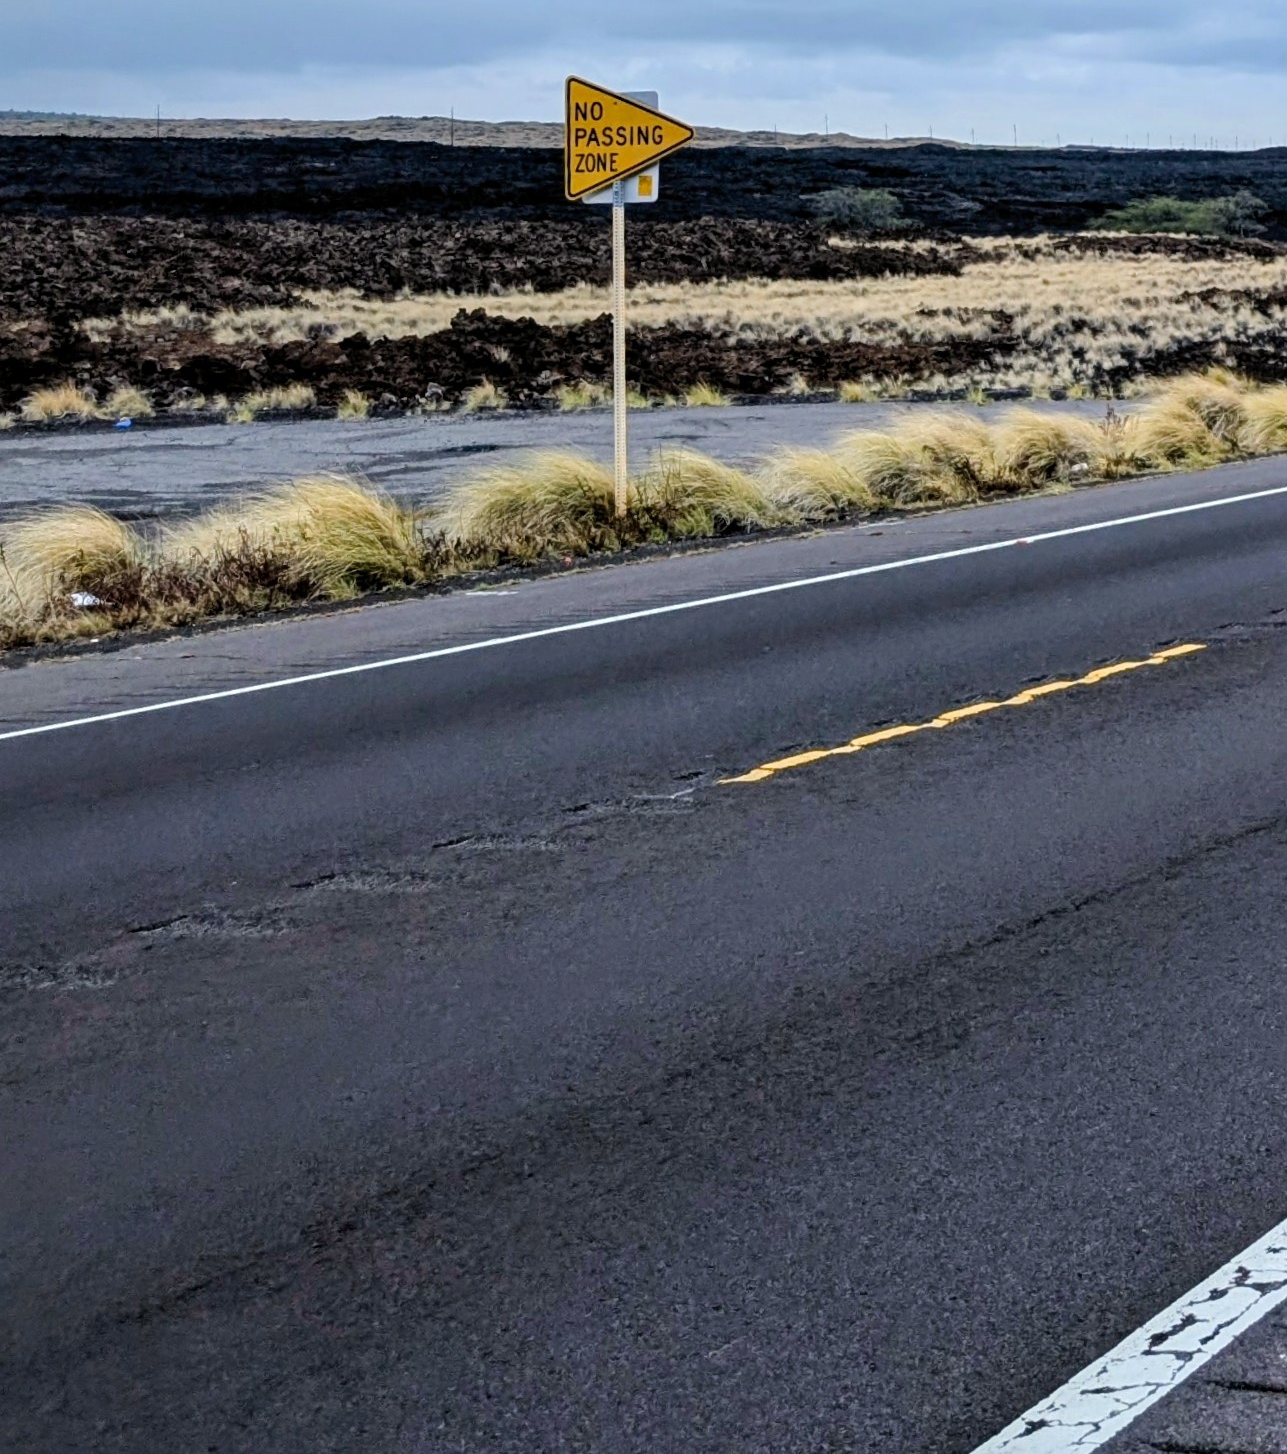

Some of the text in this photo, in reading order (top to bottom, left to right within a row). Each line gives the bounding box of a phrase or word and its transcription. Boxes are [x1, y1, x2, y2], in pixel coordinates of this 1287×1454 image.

[574, 101, 603, 121] NO
[575, 125, 663, 147] PASSING
[575, 152, 619, 173] ZONE
